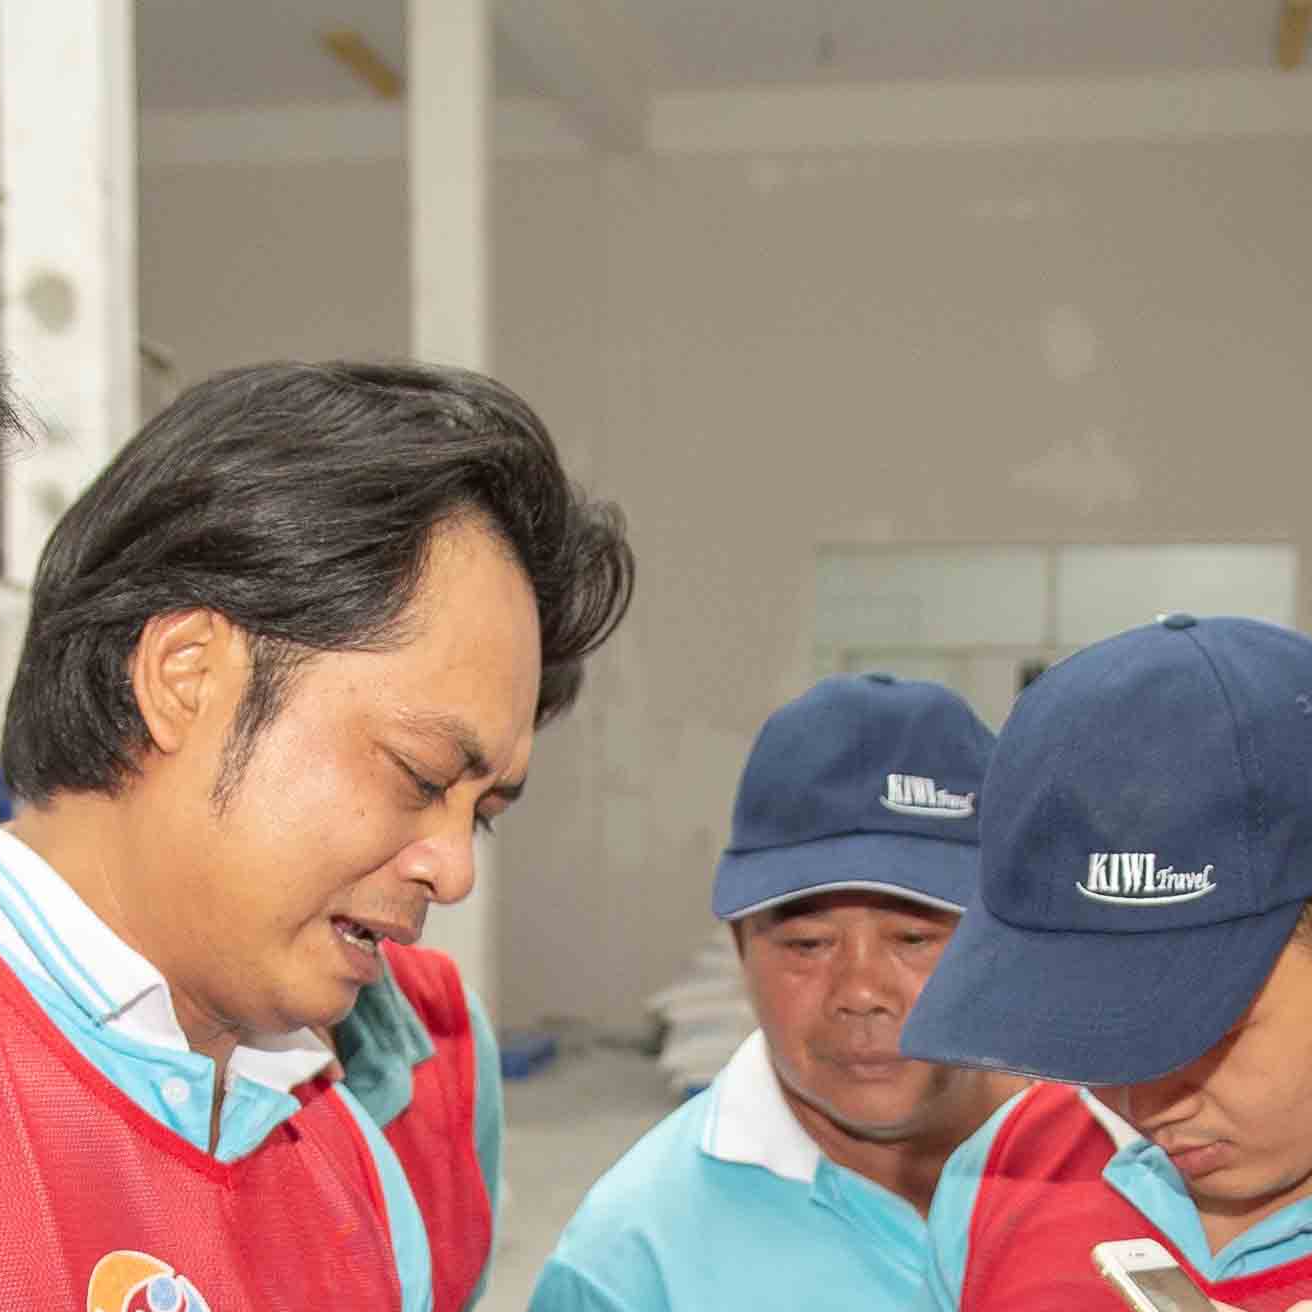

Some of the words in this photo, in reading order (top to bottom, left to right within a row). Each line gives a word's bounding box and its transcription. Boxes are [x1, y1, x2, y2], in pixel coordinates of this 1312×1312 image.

[886, 772, 937, 809] KIWI
[1087, 851, 1157, 894] KIWI
[1156, 863, 1215, 891] Travel
